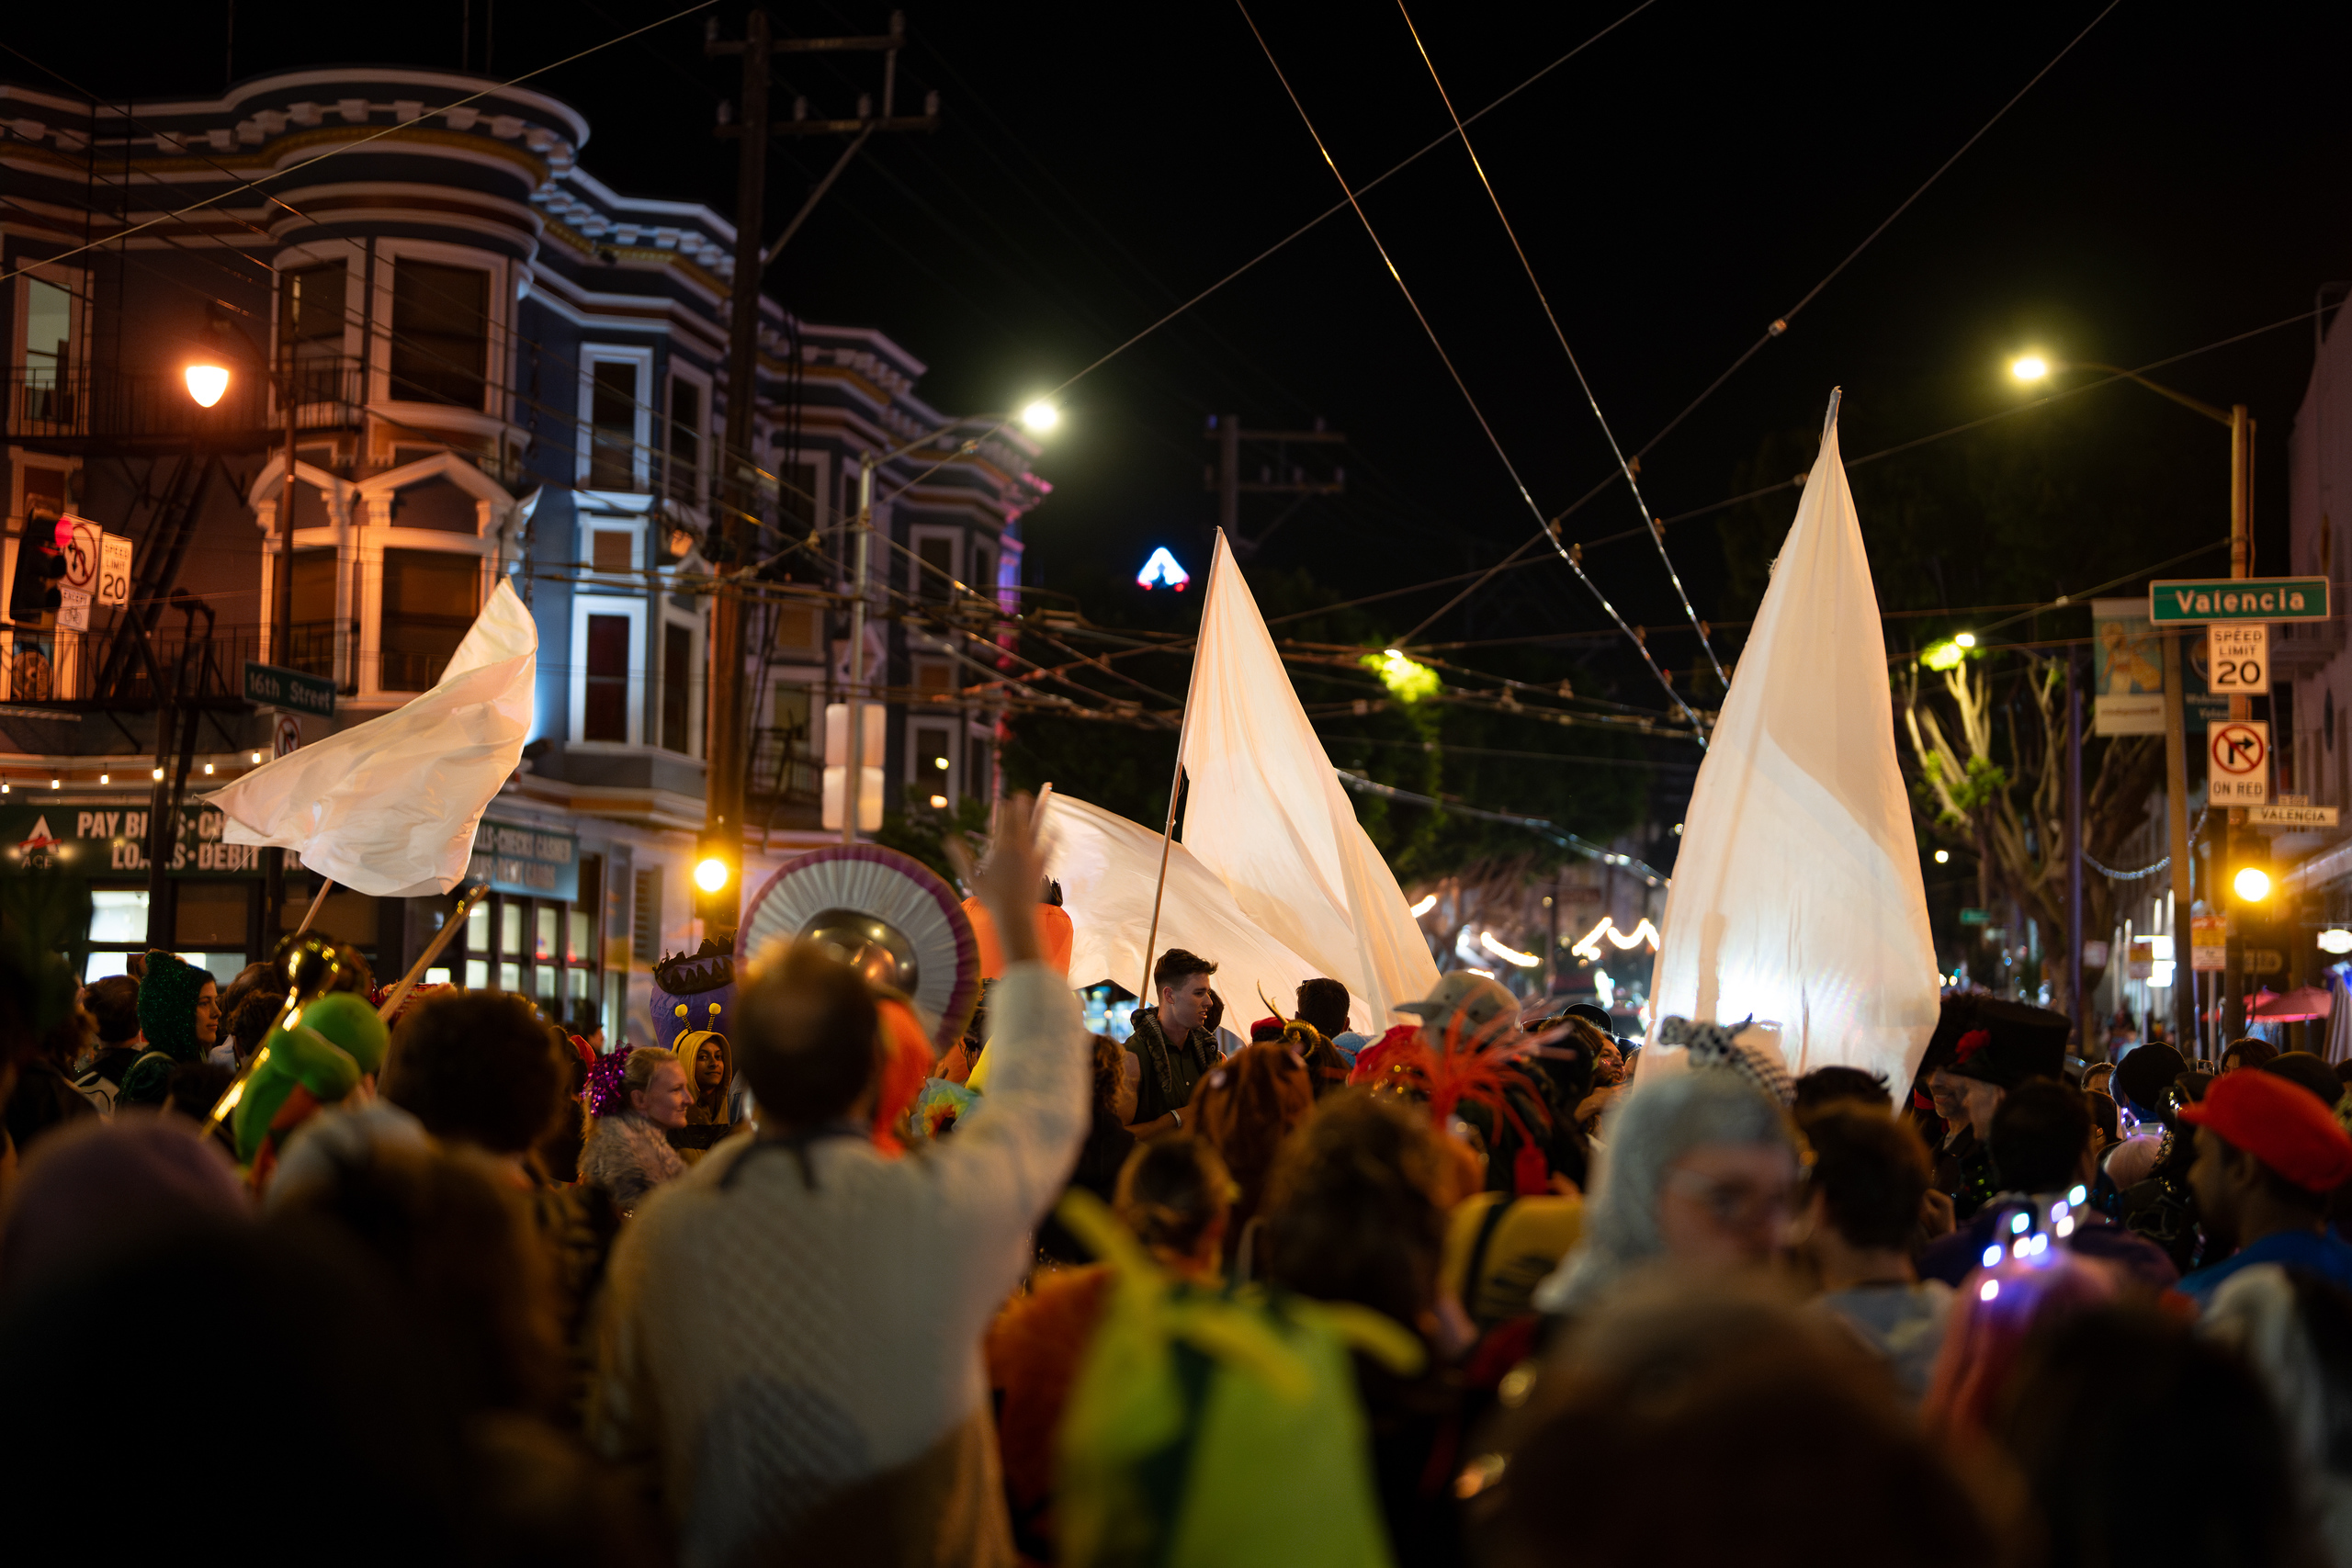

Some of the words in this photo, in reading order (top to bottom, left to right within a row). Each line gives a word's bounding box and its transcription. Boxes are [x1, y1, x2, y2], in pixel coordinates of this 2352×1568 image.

[105, 544, 130, 558] SPEED
[106, 558, 126, 572] LIMIT
[103, 573, 126, 599] 20
[2175, 587, 2305, 615] Valencia
[2214, 629, 2263, 642] SPEED
[2219, 644, 2256, 656] LIMIT
[2217, 660, 2261, 684] 20
[249, 671, 280, 698] 16th
[289, 681, 331, 711] Street
[2212, 781, 2231, 795] ON
[2236, 781, 2263, 796] RED
[2261, 807, 2326, 821] VALENCIA
[76, 811, 120, 840] PAY
[20, 854, 52, 870] ACE
[111, 842, 187, 871] LOS
